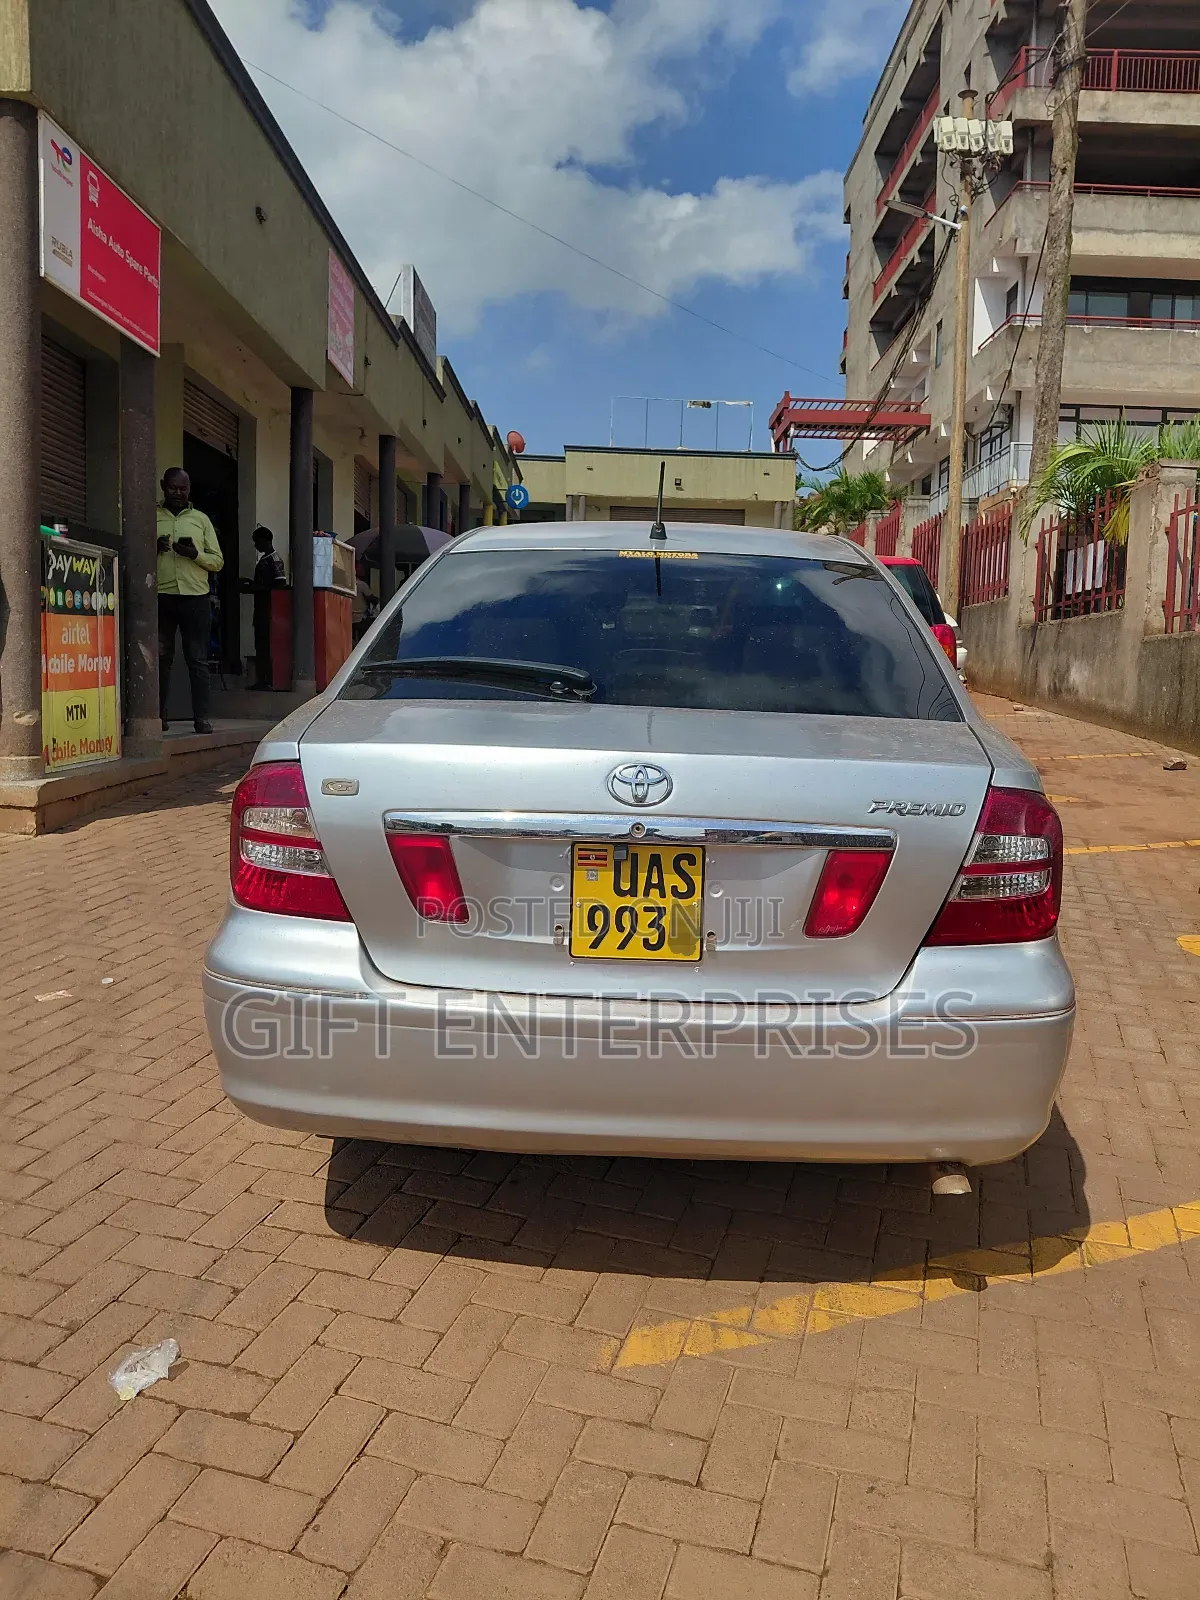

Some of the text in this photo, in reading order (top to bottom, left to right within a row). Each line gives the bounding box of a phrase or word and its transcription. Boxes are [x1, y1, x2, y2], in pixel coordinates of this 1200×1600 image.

[51, 236, 74, 259] RUBIA
[87, 217, 108, 244] Aisha
[108, 235, 125, 259] Auto
[125, 249, 144, 276] Spare
[61, 620, 91, 645] airtel
[65, 702, 87, 723] MTN
[867, 800, 967, 817] PREMIO
[609, 852, 697, 900] UAS
